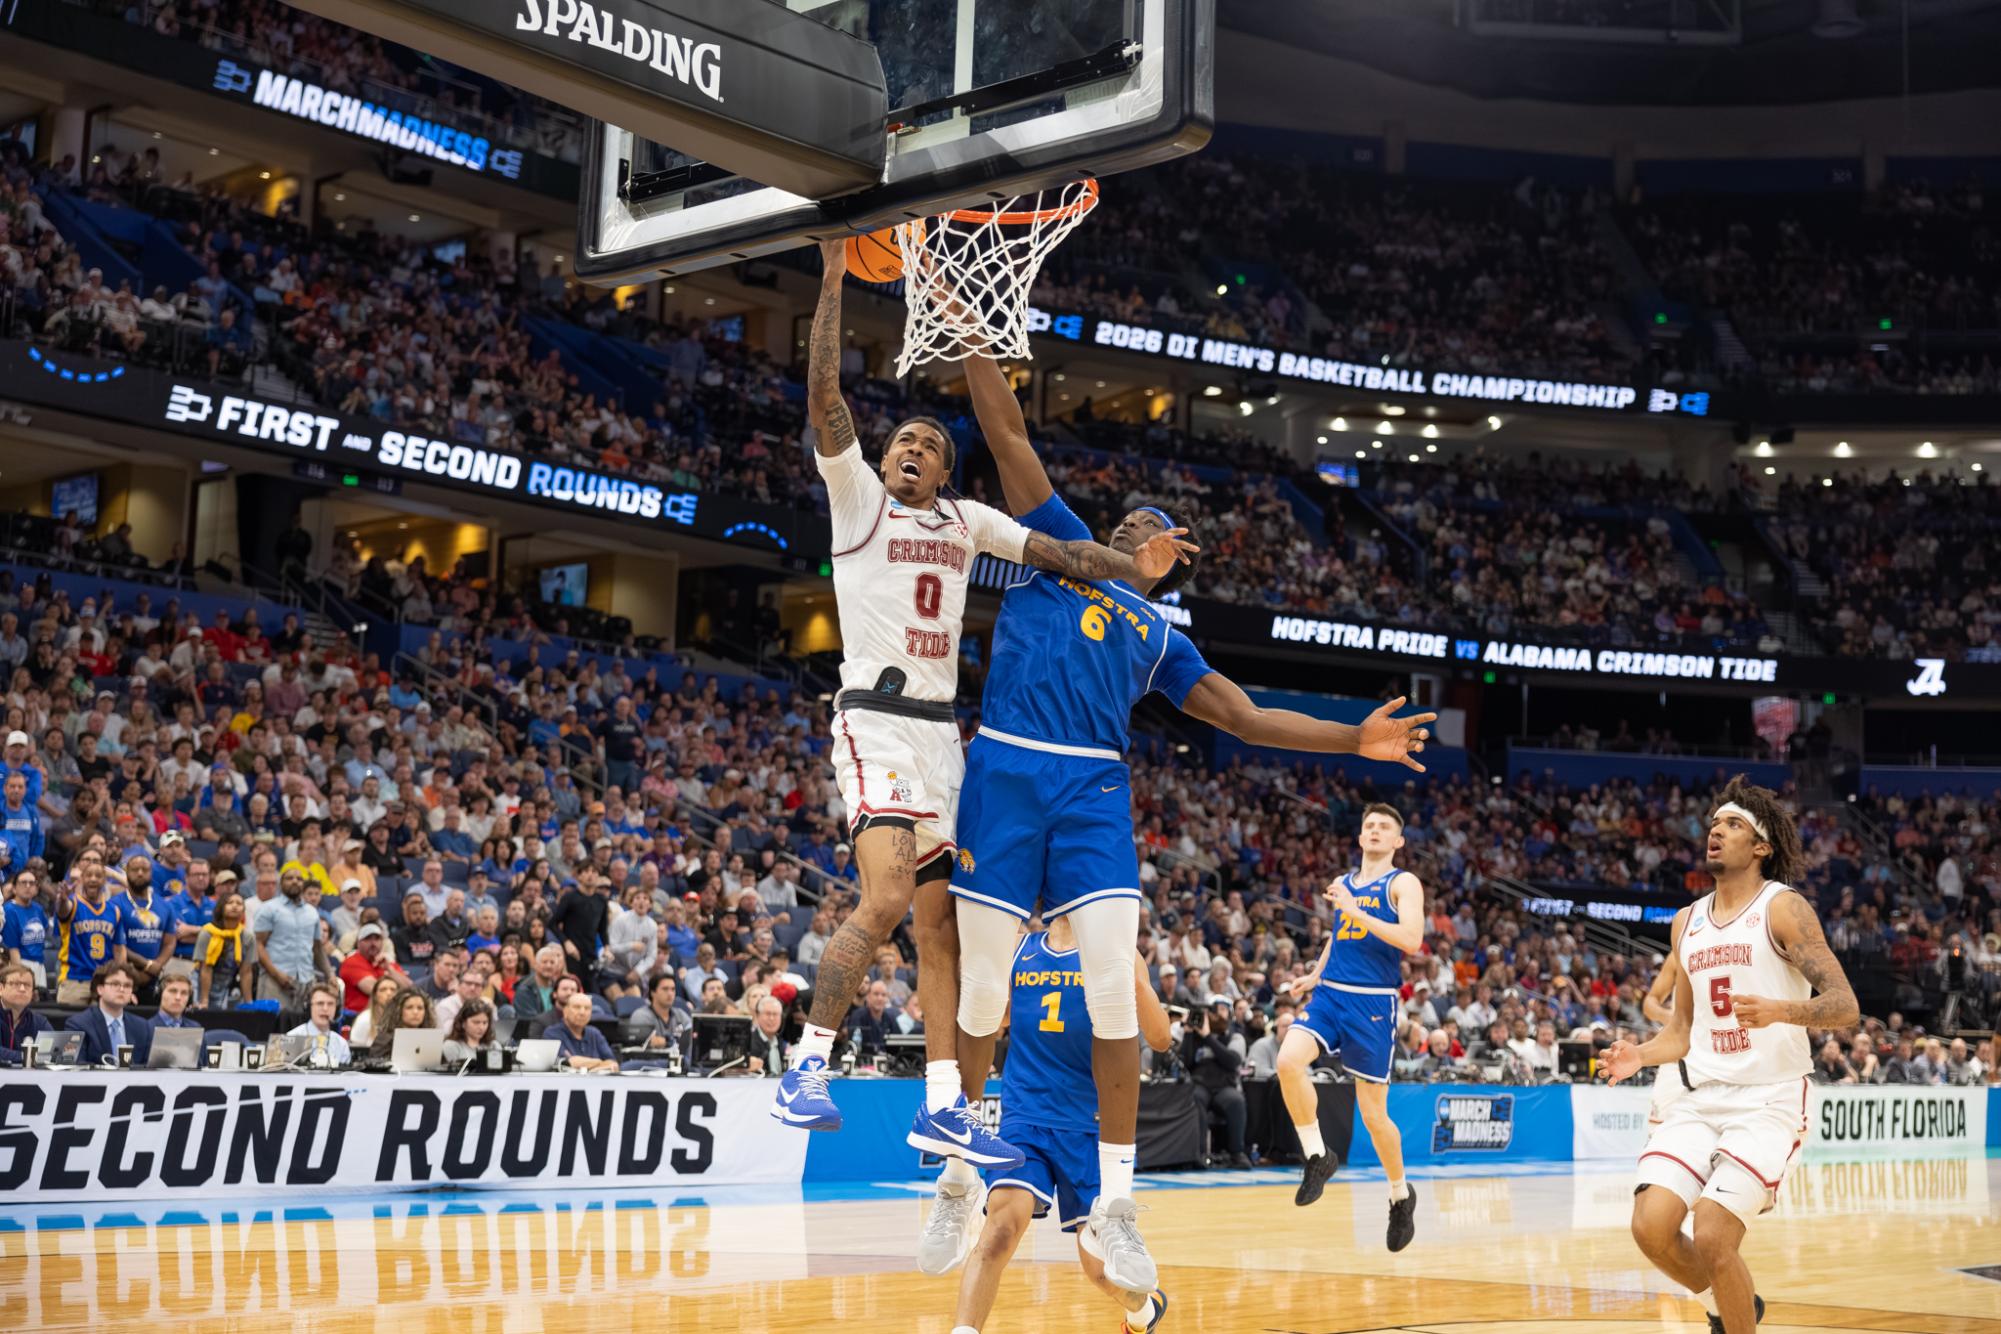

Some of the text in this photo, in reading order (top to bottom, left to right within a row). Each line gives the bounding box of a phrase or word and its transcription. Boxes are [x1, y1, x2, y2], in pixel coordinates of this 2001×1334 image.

[516, 0, 721, 101] SPALDING
[1095, 321, 1636, 409] 2026 DI MEN'S BASKETBALL CHAMPIONSHIP
[216, 395, 663, 519] FIRST AND SECOND ROUNDS
[888, 537, 967, 576] CRIMSON
[913, 571, 944, 621] 0
[1058, 575, 1149, 641] HOFSTRA
[1081, 604, 1112, 641] 6
[905, 626, 951, 659] TIDE
[1271, 616, 1777, 682] HOFSTRA PRIDE VS ALABAMA CRIMSON TIDE
[1336, 911, 1369, 940] 25
[1587, 901, 1642, 922] SECOND
[90, 933, 106, 959] 9
[1688, 943, 1752, 976] CRIMSON
[1015, 971, 1085, 987] HOFSTR
[1709, 974, 1734, 1018] 5
[1039, 992, 1065, 1033] 1
[1711, 1026, 1752, 1055] TIDE
[1449, 1099, 1492, 1121] MARCH
[1592, 1112, 1645, 1131] HOSTED BY
[1821, 1098, 1967, 1141] SOUTH FLORIDA
[0, 1084, 717, 1190] SECOND ROUNDS
[1453, 1121, 1512, 1143] MADNESS
